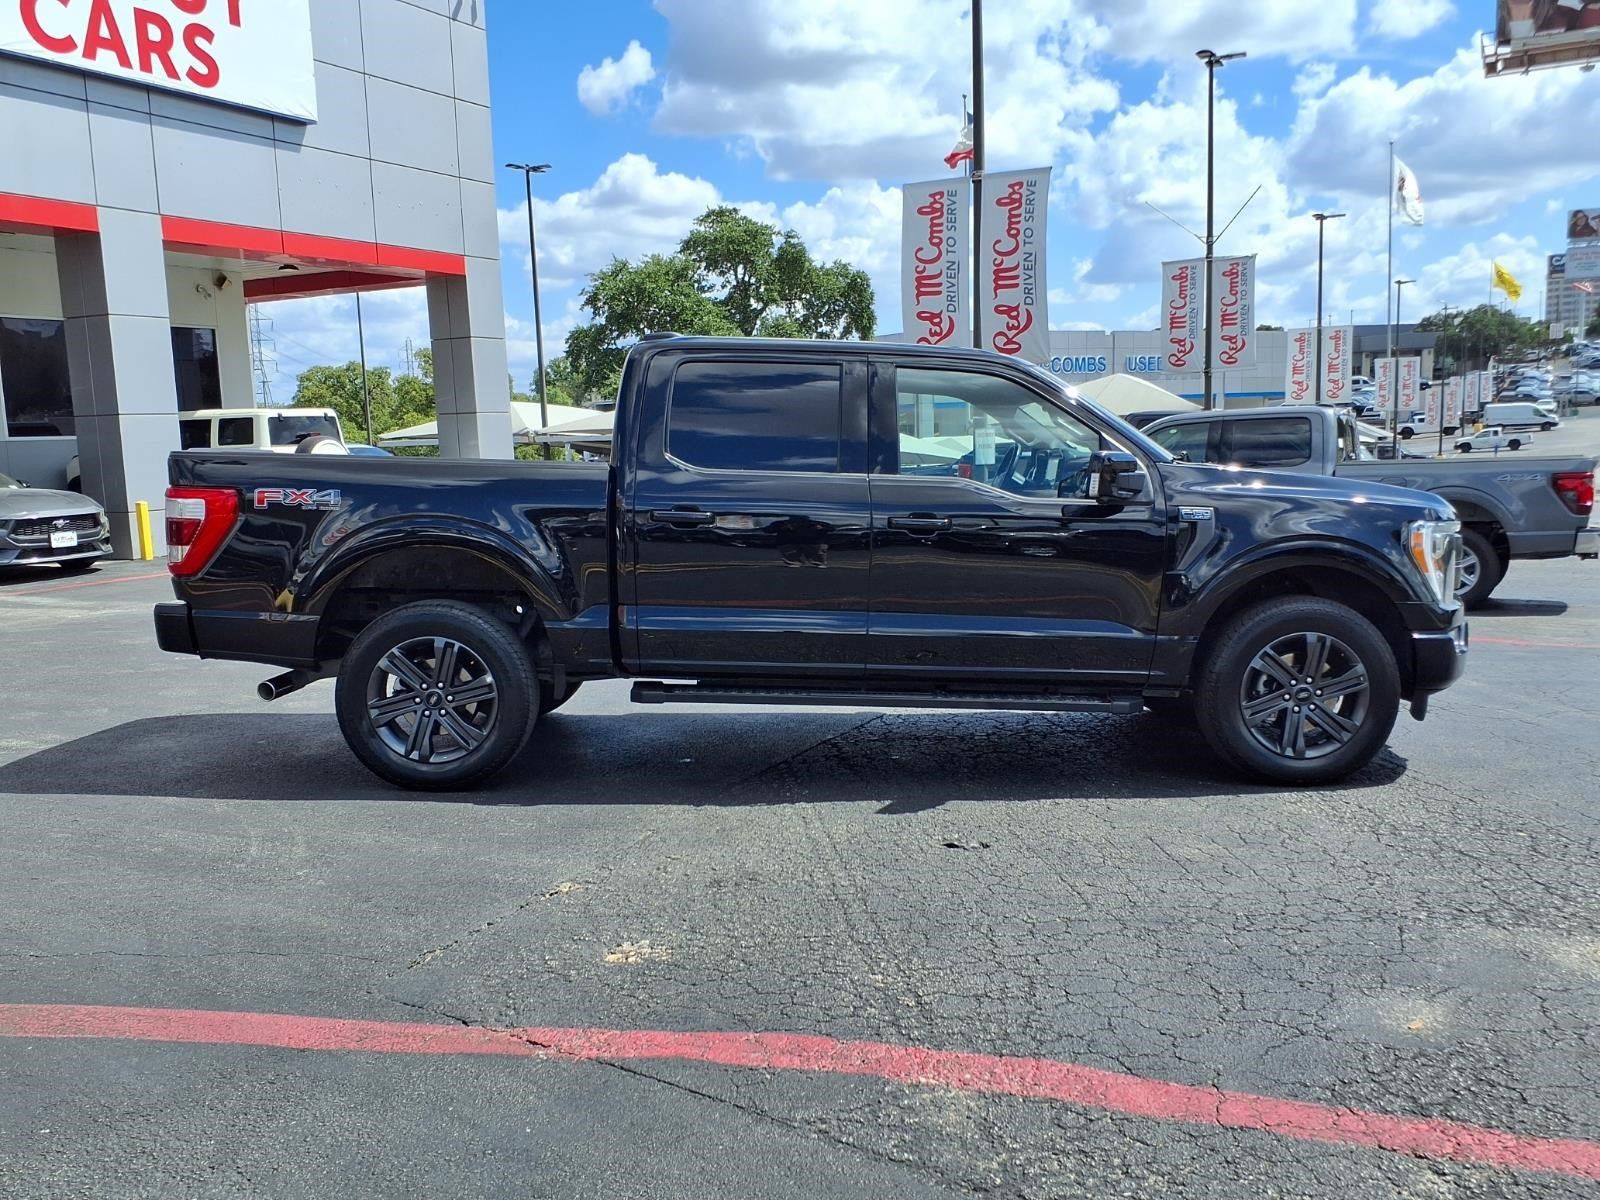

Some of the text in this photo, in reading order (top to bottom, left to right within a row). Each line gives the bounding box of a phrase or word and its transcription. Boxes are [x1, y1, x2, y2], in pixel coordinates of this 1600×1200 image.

[20, 0, 220, 89] CARS
[914, 190, 945, 306] McCombs
[946, 189, 958, 313] DRIVEN TO SERVE
[992, 180, 1033, 355] Red McCombs
[1023, 179, 1037, 306] DRIVEN TO SERVE
[1167, 265, 1195, 368] Red McCombs
[1188, 264, 1198, 340] DRIVEN TO SERVE
[1219, 261, 1246, 365] Red McCombs
[1239, 261, 1249, 337] DRIVEN TO SERVE
[1291, 332, 1306, 378] McCombs
[1327, 329, 1342, 377] McCombs
[253, 487, 342, 510] FX4
